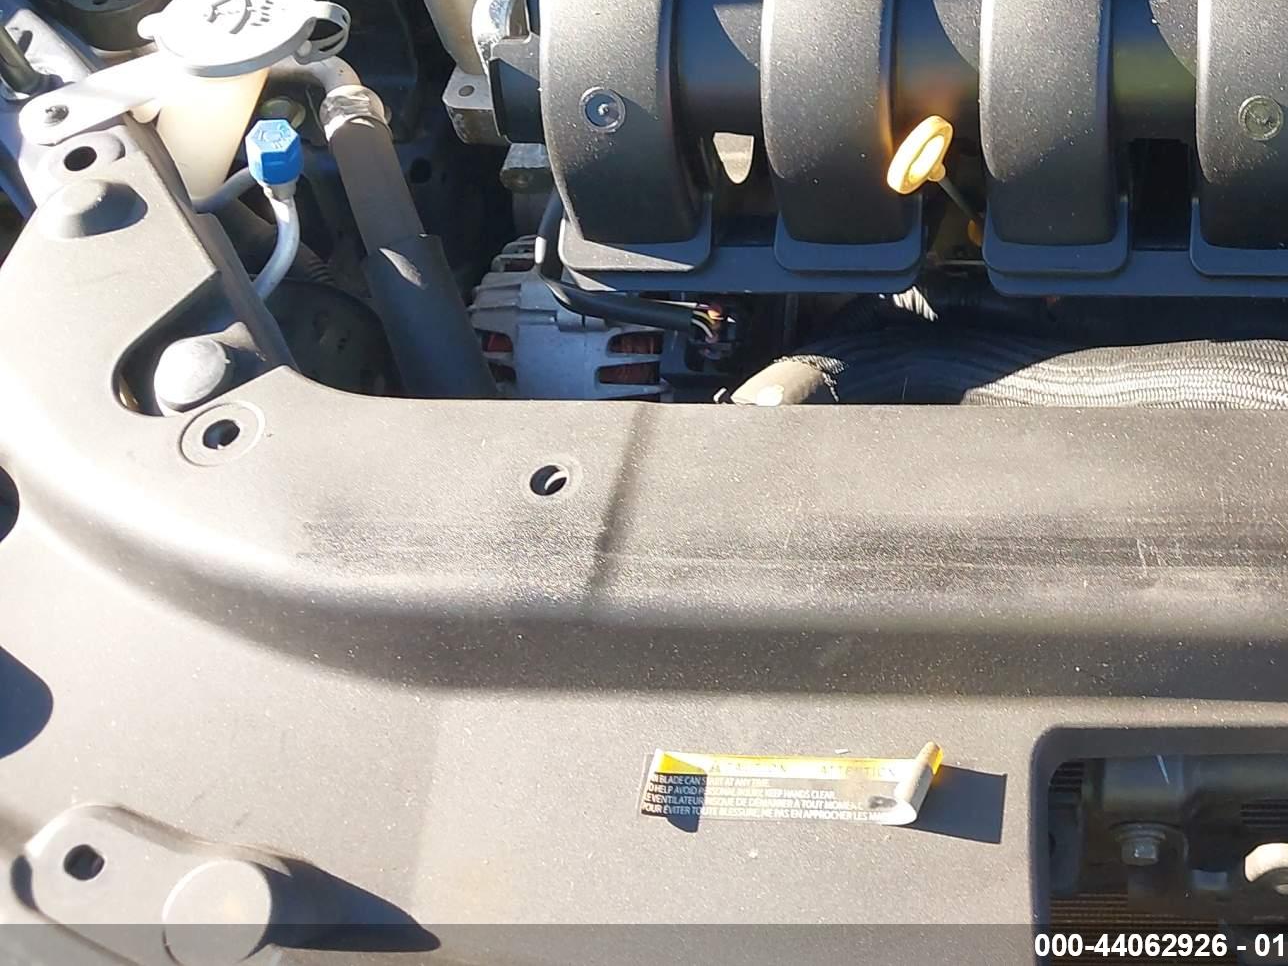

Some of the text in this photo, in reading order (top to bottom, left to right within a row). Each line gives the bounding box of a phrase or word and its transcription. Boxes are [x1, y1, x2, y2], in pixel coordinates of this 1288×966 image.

[659, 775, 683, 785] BLADE
[684, 776, 700, 785] CAN
[655, 784, 672, 794] HELP
[672, 786, 696, 795] AVOID
[652, 793, 704, 805] VENTILATEUR
[801, 799, 825, 809] TOUT
